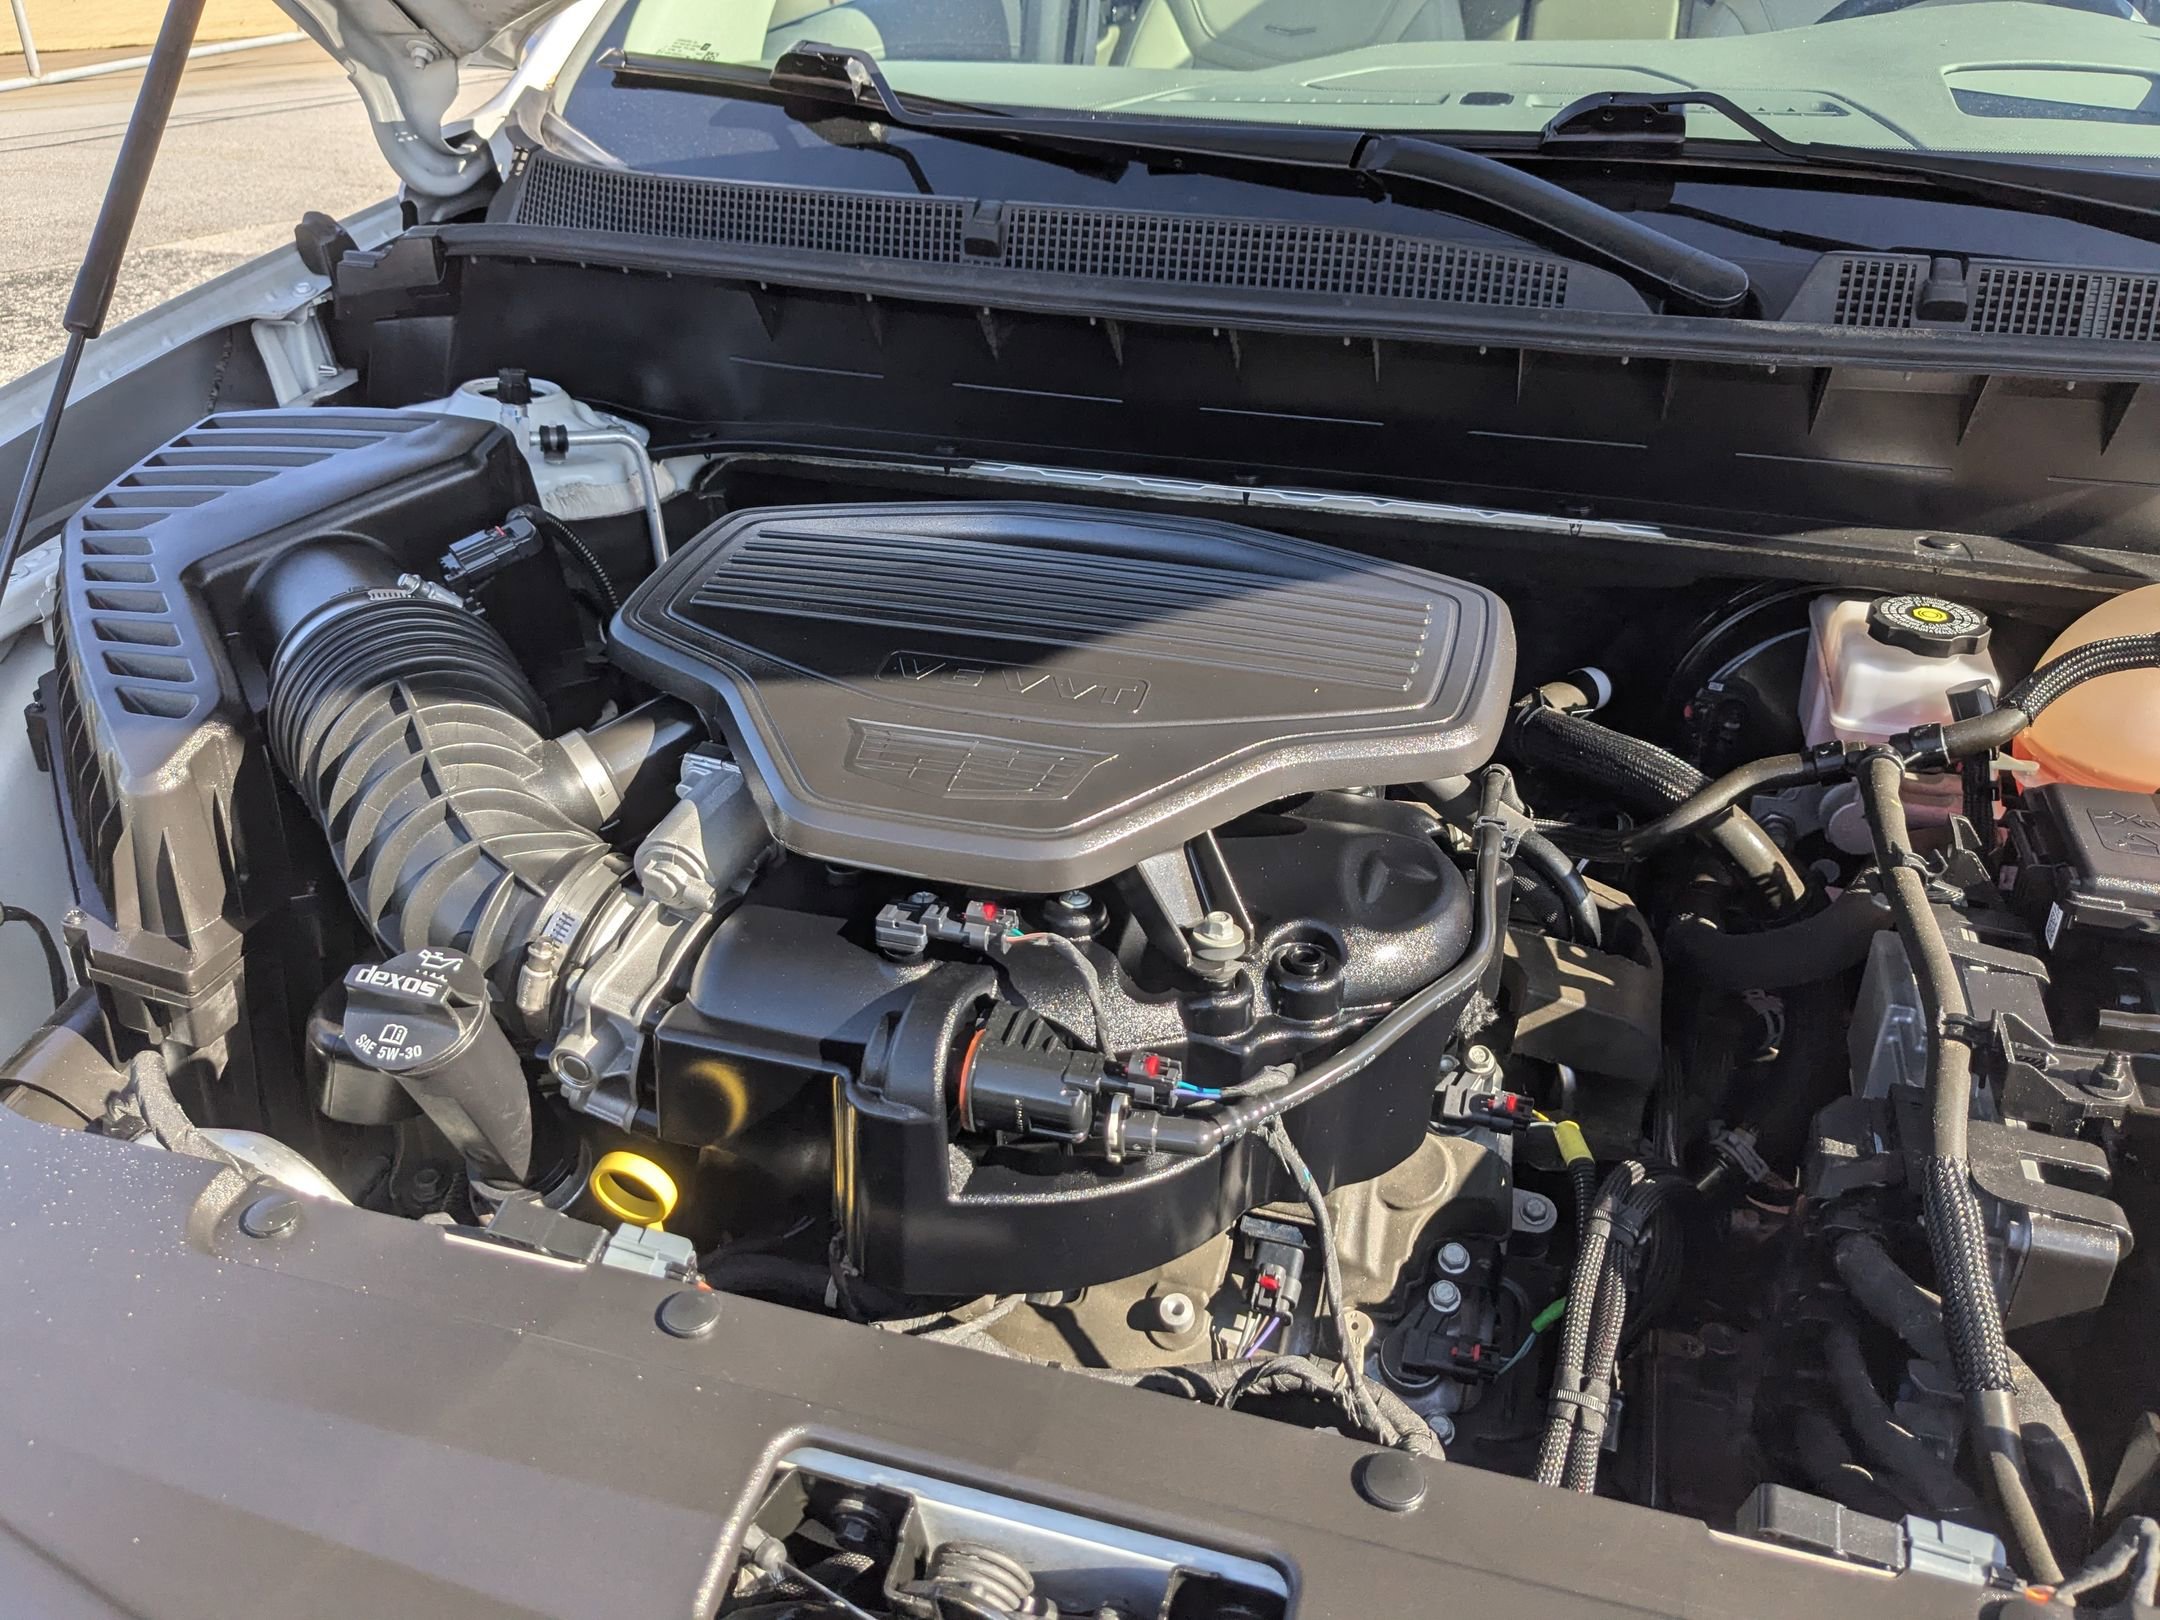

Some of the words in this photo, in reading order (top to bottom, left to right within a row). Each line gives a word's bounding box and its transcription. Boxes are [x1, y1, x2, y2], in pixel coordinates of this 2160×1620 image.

[355, 965, 440, 998] dexos
[355, 1033, 378, 1055] SAE
[377, 1044, 423, 1061] 5W-30
